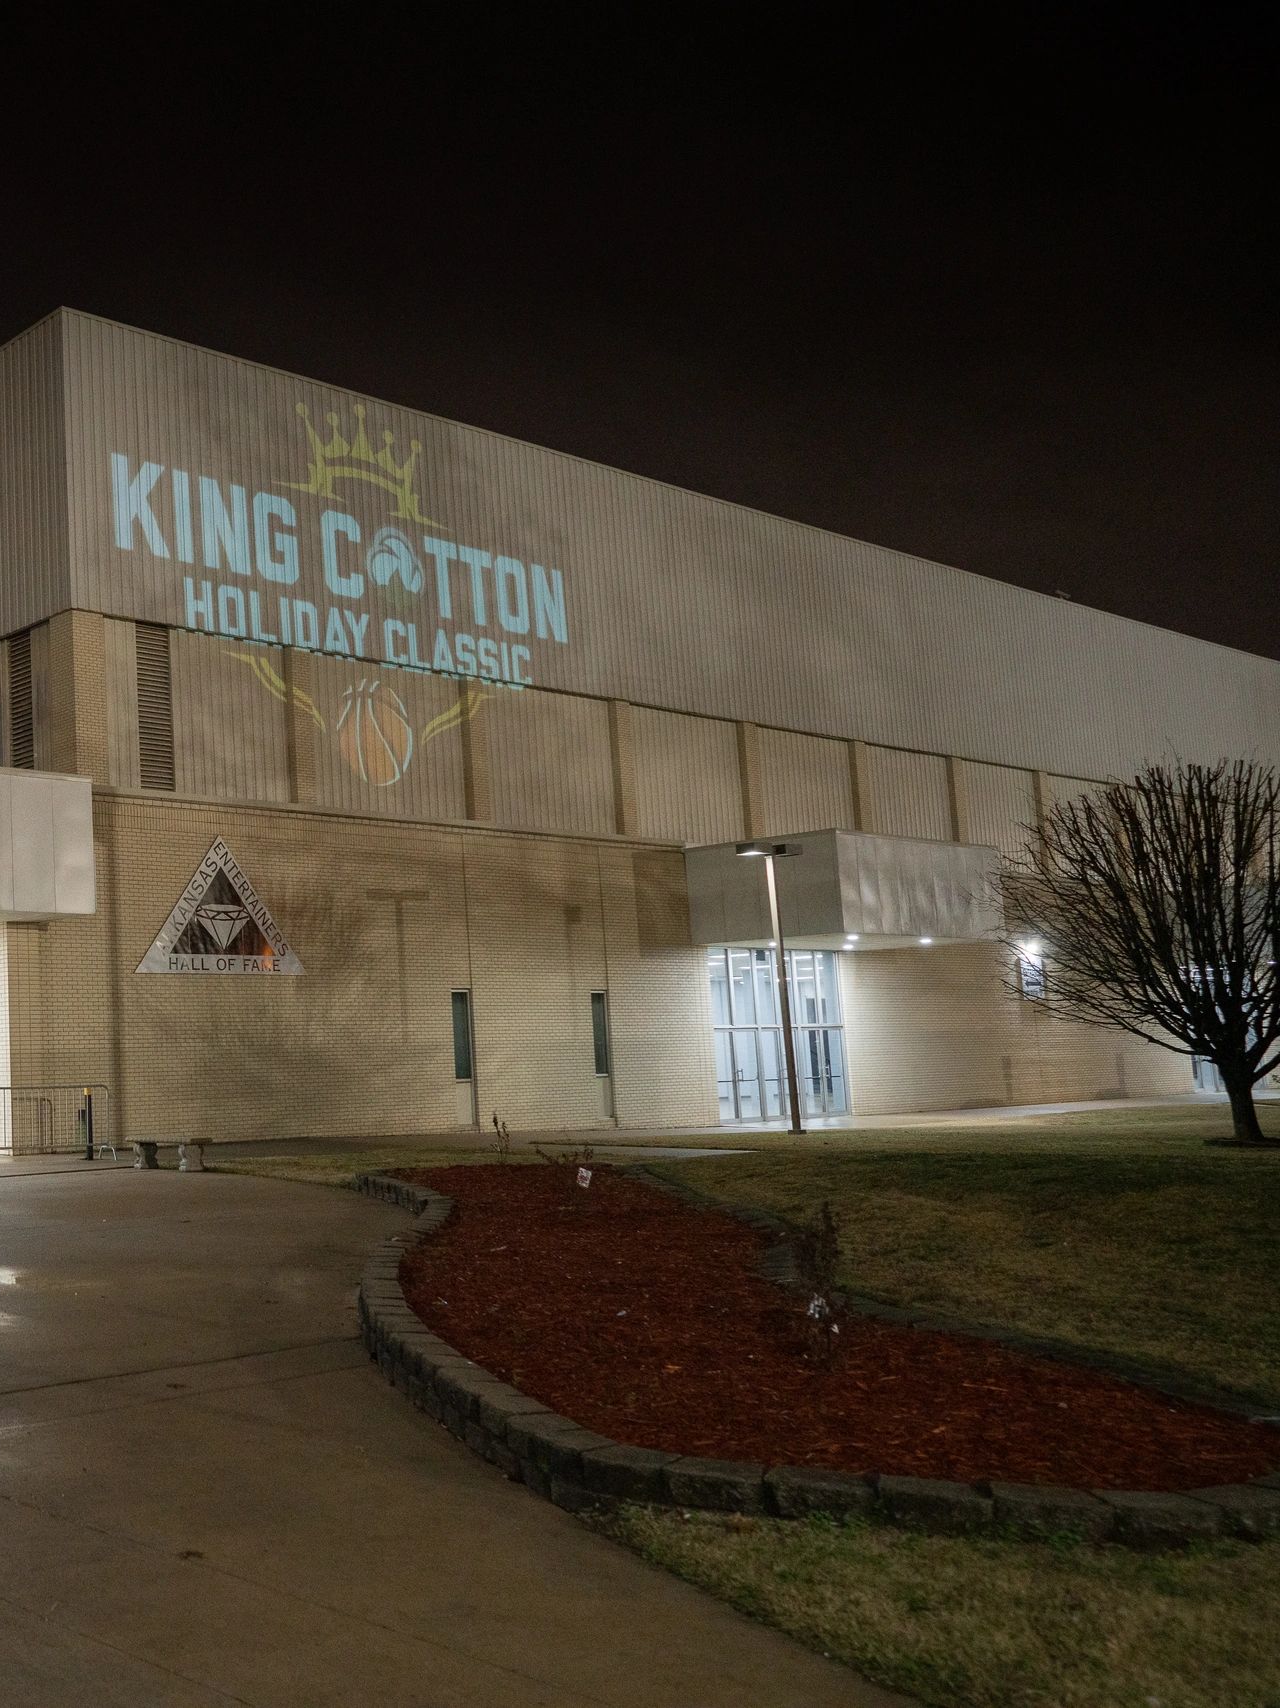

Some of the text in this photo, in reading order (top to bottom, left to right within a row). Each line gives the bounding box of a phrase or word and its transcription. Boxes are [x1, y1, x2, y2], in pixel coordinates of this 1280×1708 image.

[111, 452, 299, 585] KING
[183, 577, 533, 691] HOLIDAY CLASSIC
[213, 841, 289, 958] ENTERTAINERS
[169, 957, 210, 972] HALL
[216, 958, 236, 972] OF
